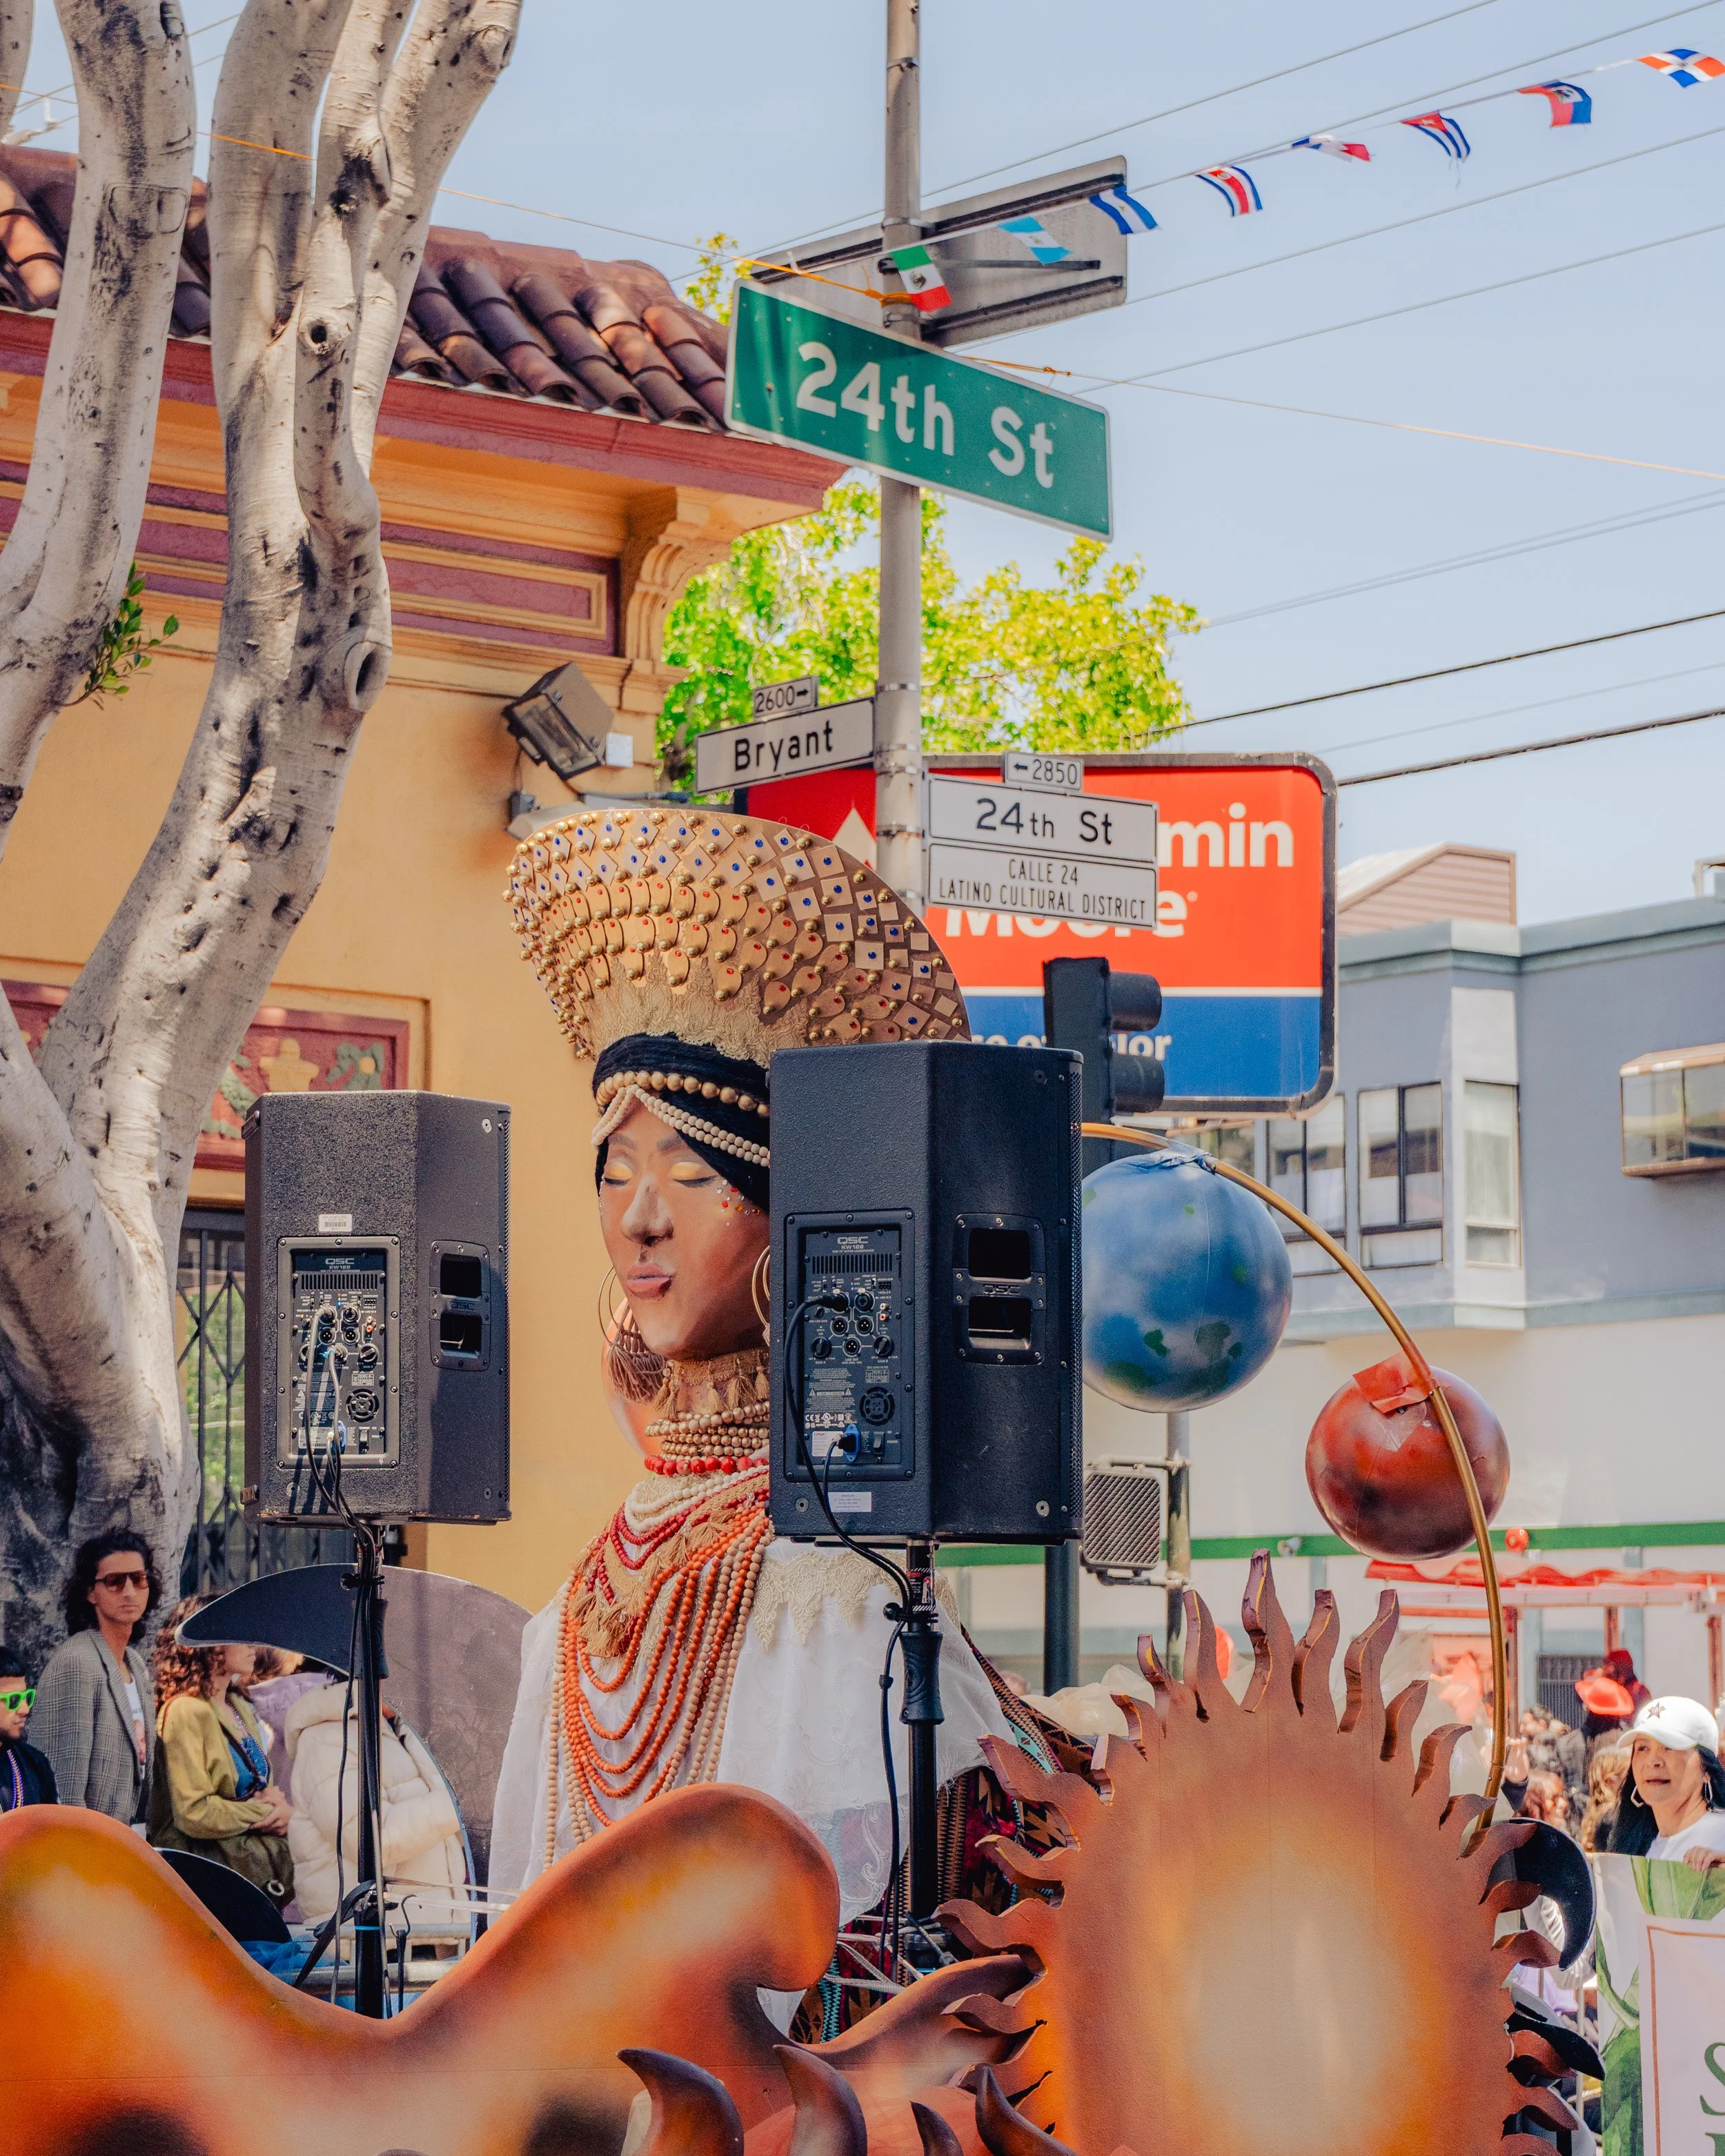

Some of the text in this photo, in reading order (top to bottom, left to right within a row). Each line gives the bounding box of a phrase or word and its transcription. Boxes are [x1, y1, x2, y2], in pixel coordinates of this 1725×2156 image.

[796, 341, 1054, 489] 24th St
[755, 685, 795, 713] 2600
[734, 720, 833, 771] Bryant
[1032, 759, 1077, 784] 2850
[976, 798, 1112, 845] 24th St
[1156, 802, 1294, 868] min
[1009, 858, 1078, 885] CALLE 24
[940, 878, 1146, 920] LATINO CULTURAL DISTRICT
[837, 1236, 869, 1245] QSC
[1699, 2042, 1725, 2115] S
